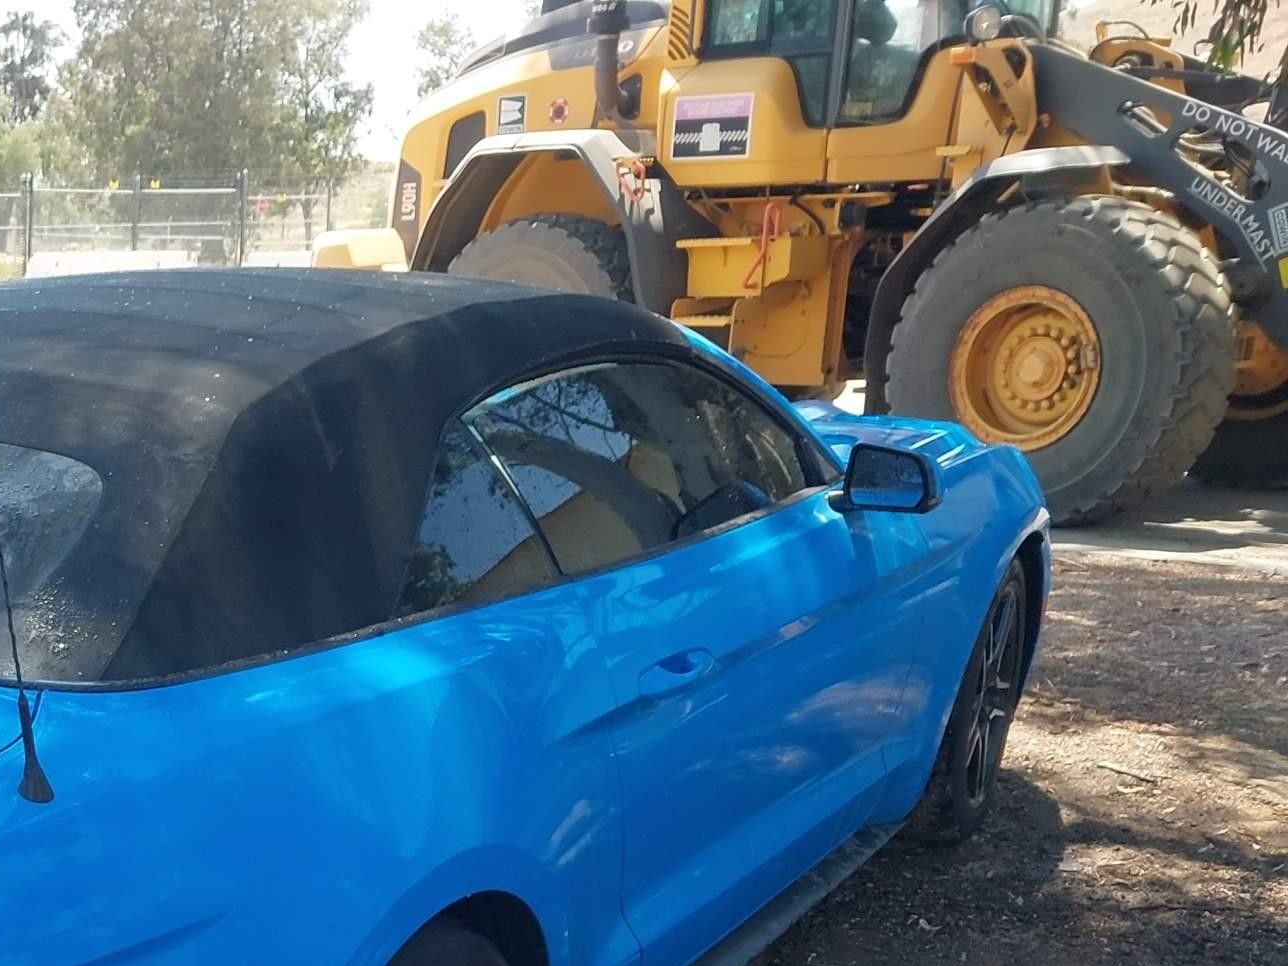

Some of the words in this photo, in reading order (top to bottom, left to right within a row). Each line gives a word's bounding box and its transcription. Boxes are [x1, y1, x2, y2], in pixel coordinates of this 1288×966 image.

[1182, 101, 1211, 122] DO
[1215, 114, 1259, 141] NOT
[400, 182, 417, 221] L90H
[1191, 176, 1246, 222] UNDER
[1242, 214, 1277, 260] MAST
